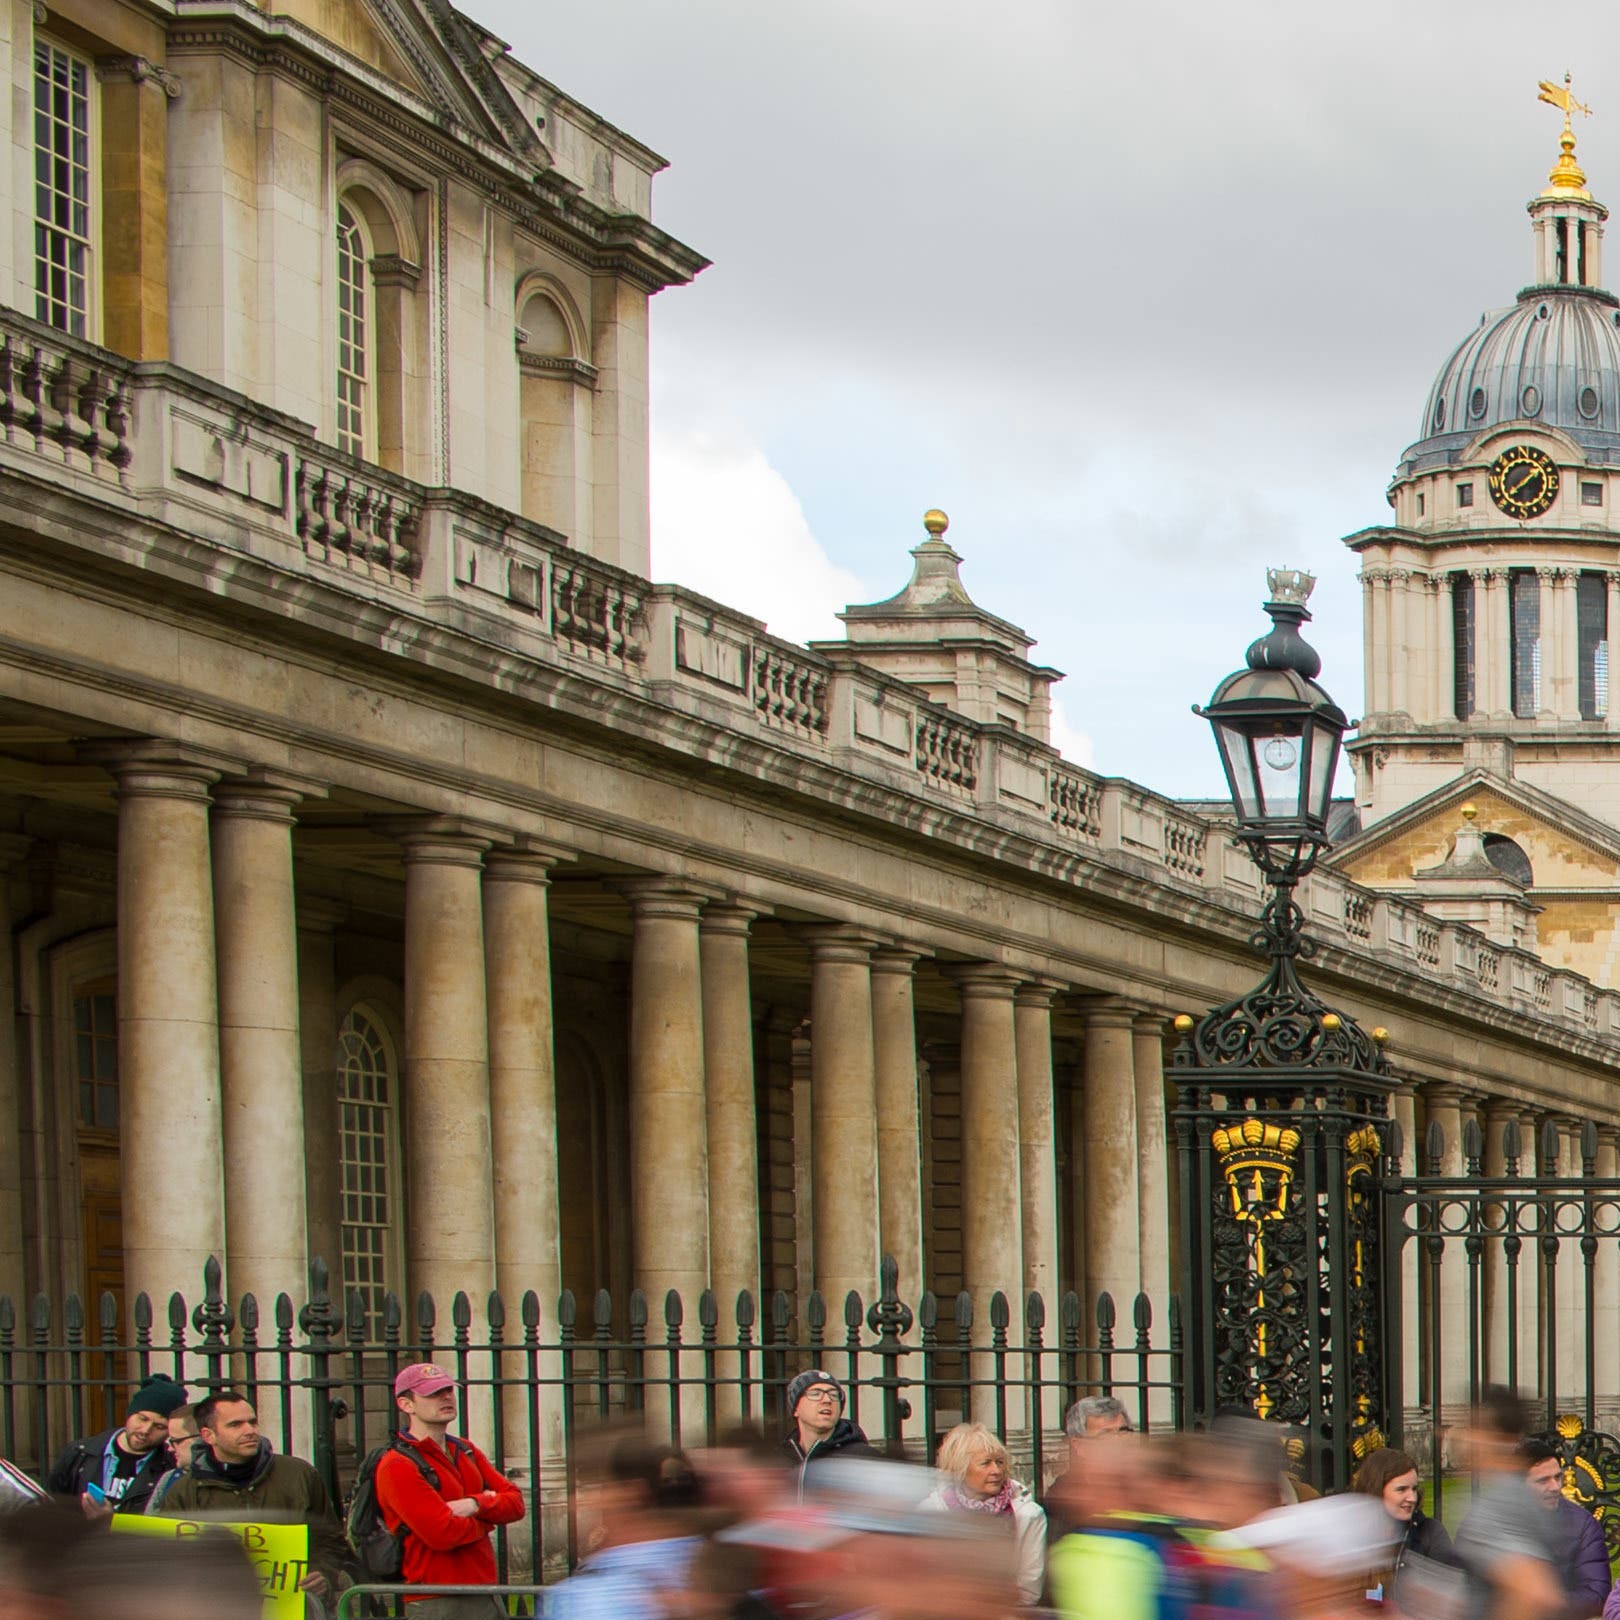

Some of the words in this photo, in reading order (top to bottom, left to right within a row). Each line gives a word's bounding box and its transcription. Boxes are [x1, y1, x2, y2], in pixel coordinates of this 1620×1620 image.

[1518, 445, 1529, 459] N
[1489, 475, 1501, 489] W
[1548, 475, 1559, 490] E
[1519, 505, 1528, 519] S
